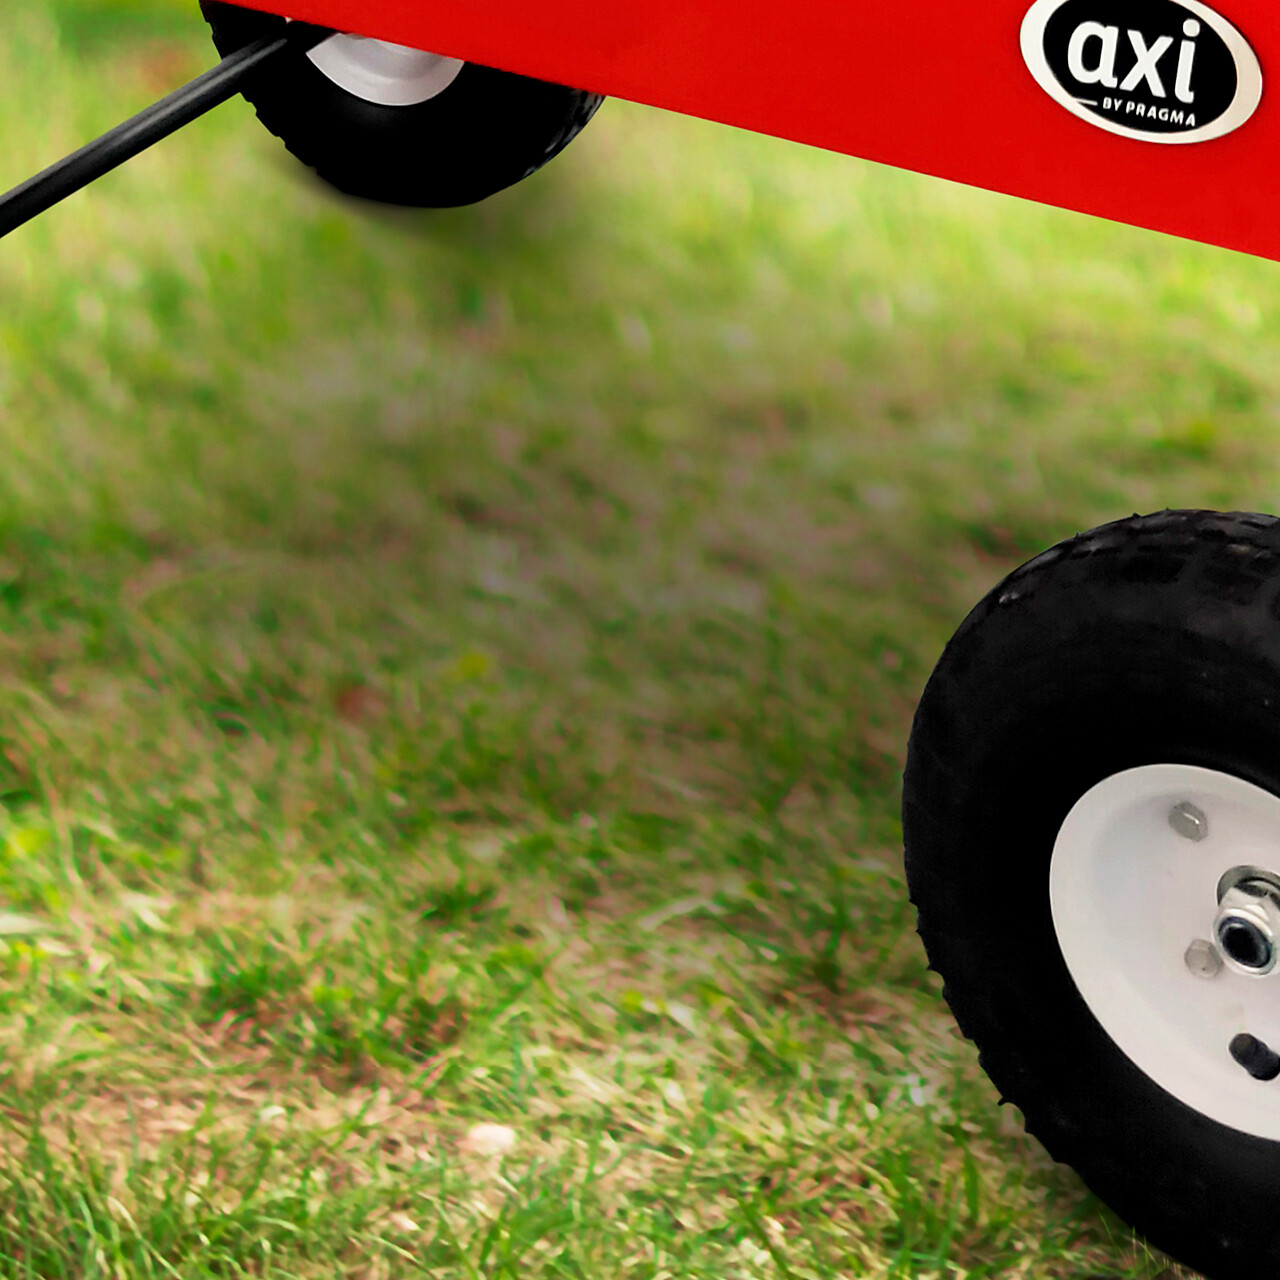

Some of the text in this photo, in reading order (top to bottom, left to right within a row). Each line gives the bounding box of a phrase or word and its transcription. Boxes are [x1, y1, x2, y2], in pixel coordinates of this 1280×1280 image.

[1067, 18, 1201, 104] axi
[1102, 96, 1196, 127] BY PRAGMA
